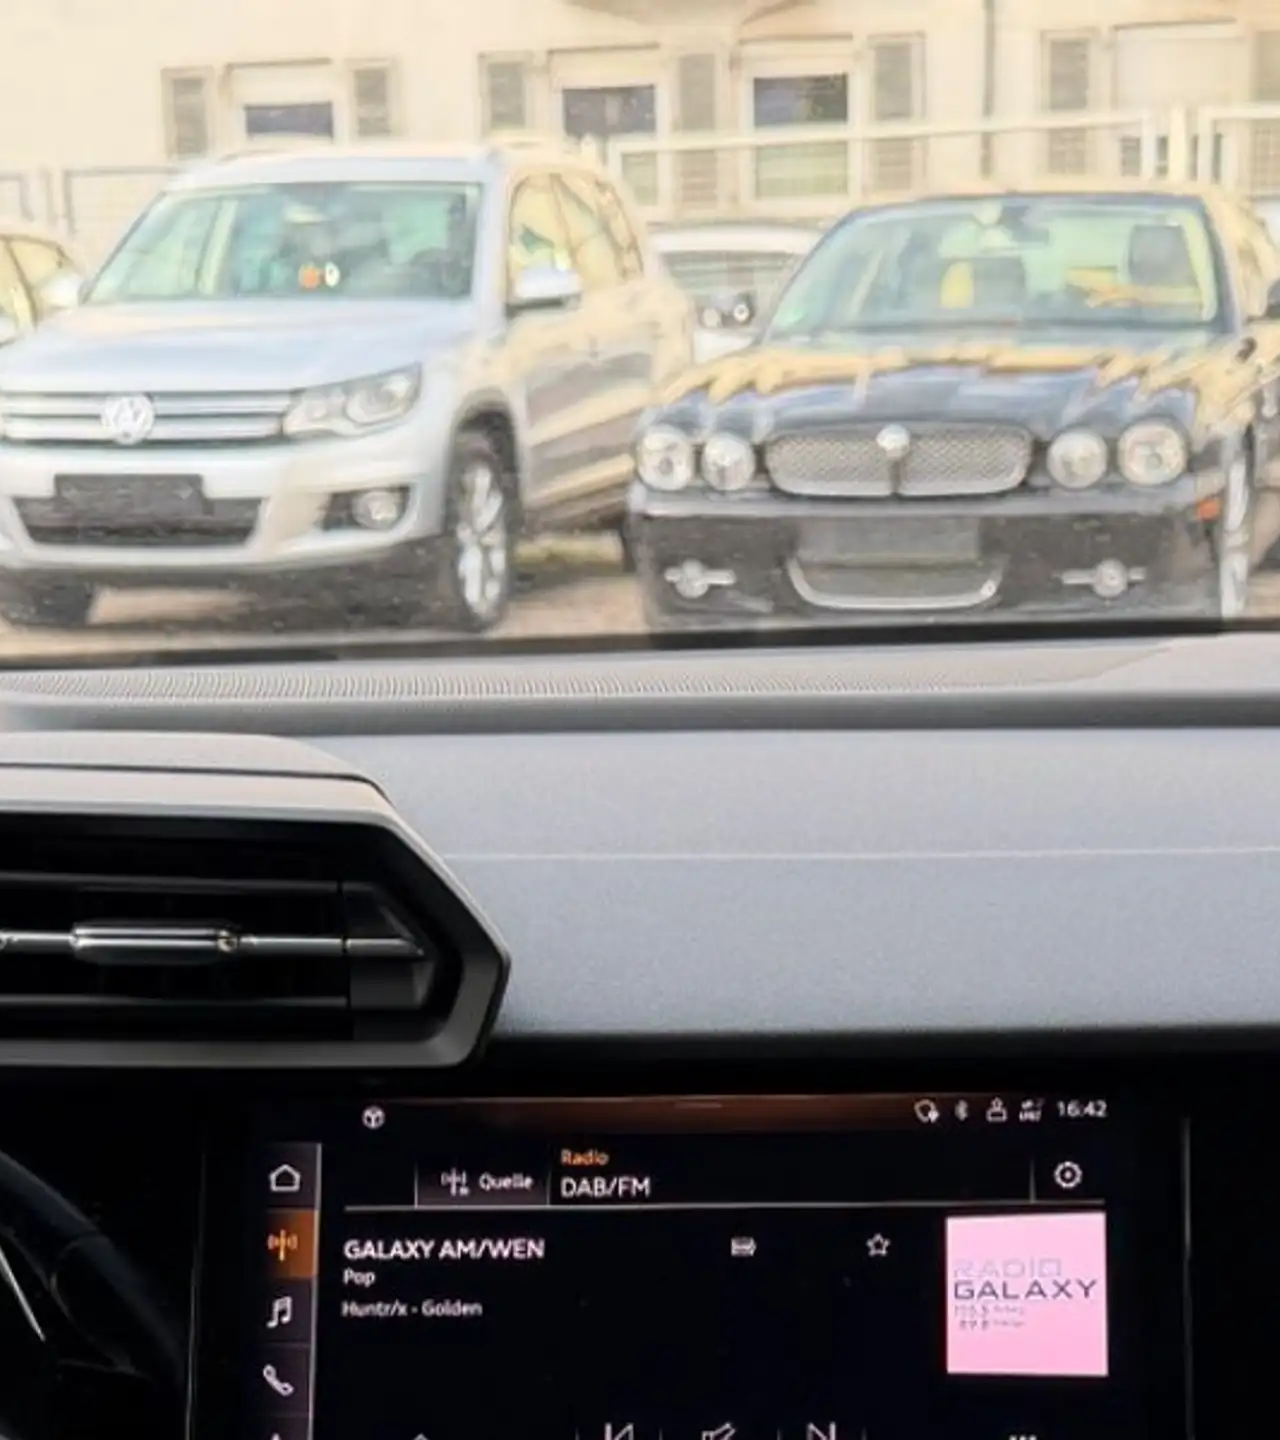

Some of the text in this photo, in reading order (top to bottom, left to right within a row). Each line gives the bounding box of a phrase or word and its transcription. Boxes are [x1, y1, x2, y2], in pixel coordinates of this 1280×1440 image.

[1057, 1099, 1108, 1118] 16:42
[561, 1149, 610, 1166] Radio
[479, 1172, 534, 1191] Quelle
[560, 1177, 651, 1198] DAB/FM
[344, 1238, 545, 1260] GALAXY AM/WEN
[343, 1268, 375, 1287] Pop
[954, 1279, 1097, 1300] GALAXY
[342, 1299, 408, 1317] Huntr/x
[421, 1299, 483, 1317] Golden
